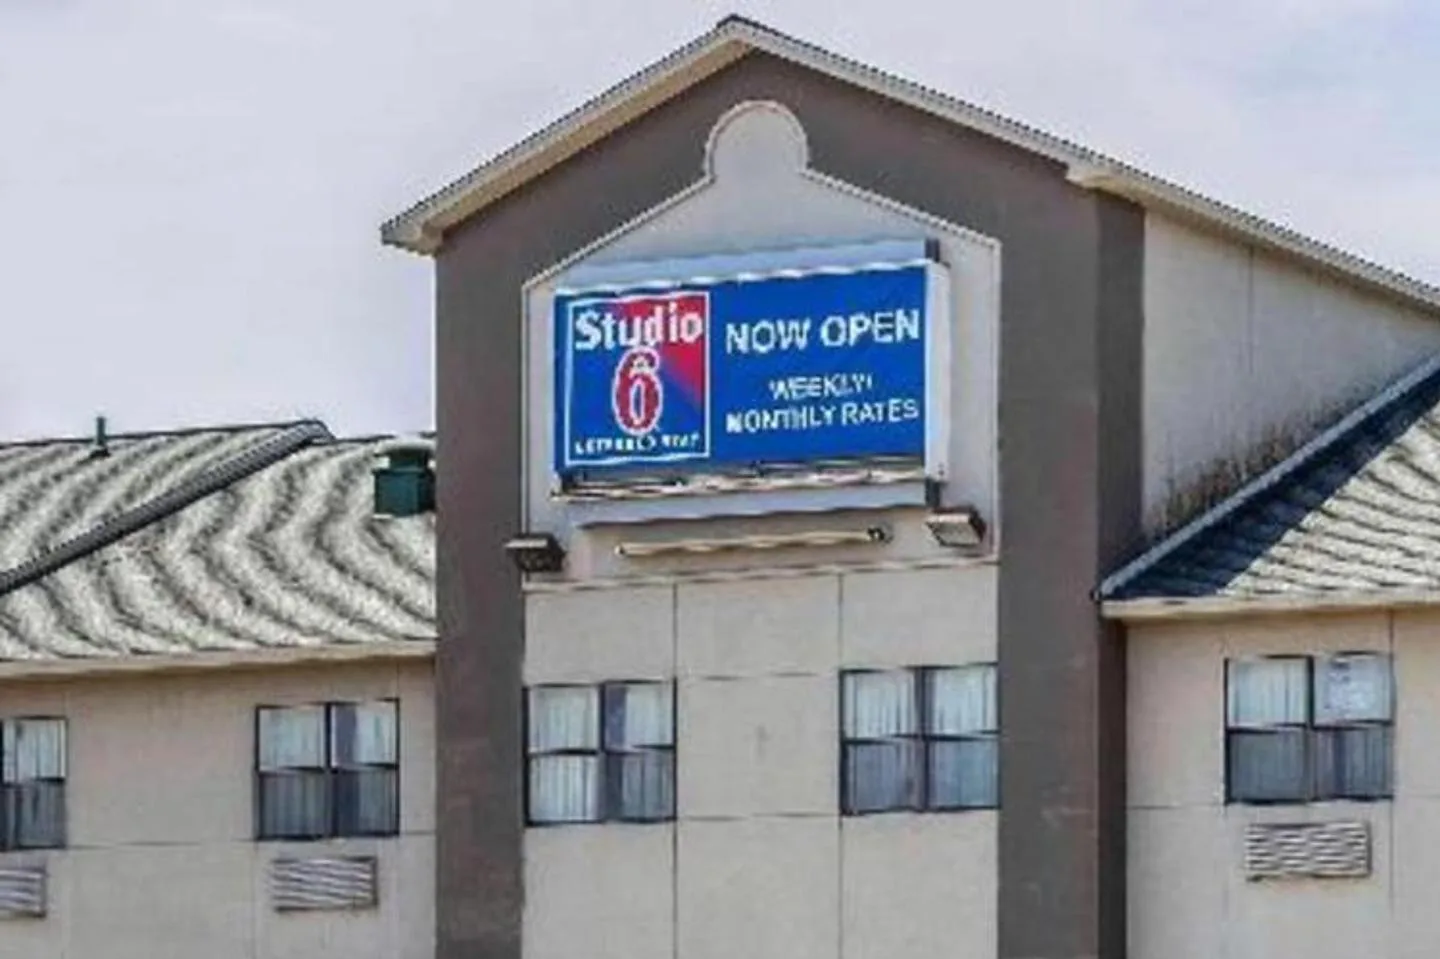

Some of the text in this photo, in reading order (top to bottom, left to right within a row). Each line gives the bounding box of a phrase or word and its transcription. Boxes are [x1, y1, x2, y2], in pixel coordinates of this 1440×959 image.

[575, 301, 703, 350] Studio
[725, 308, 920, 355] NOW OPEN
[611, 346, 663, 436] 6
[726, 397, 920, 433] MONTHLY RATES
